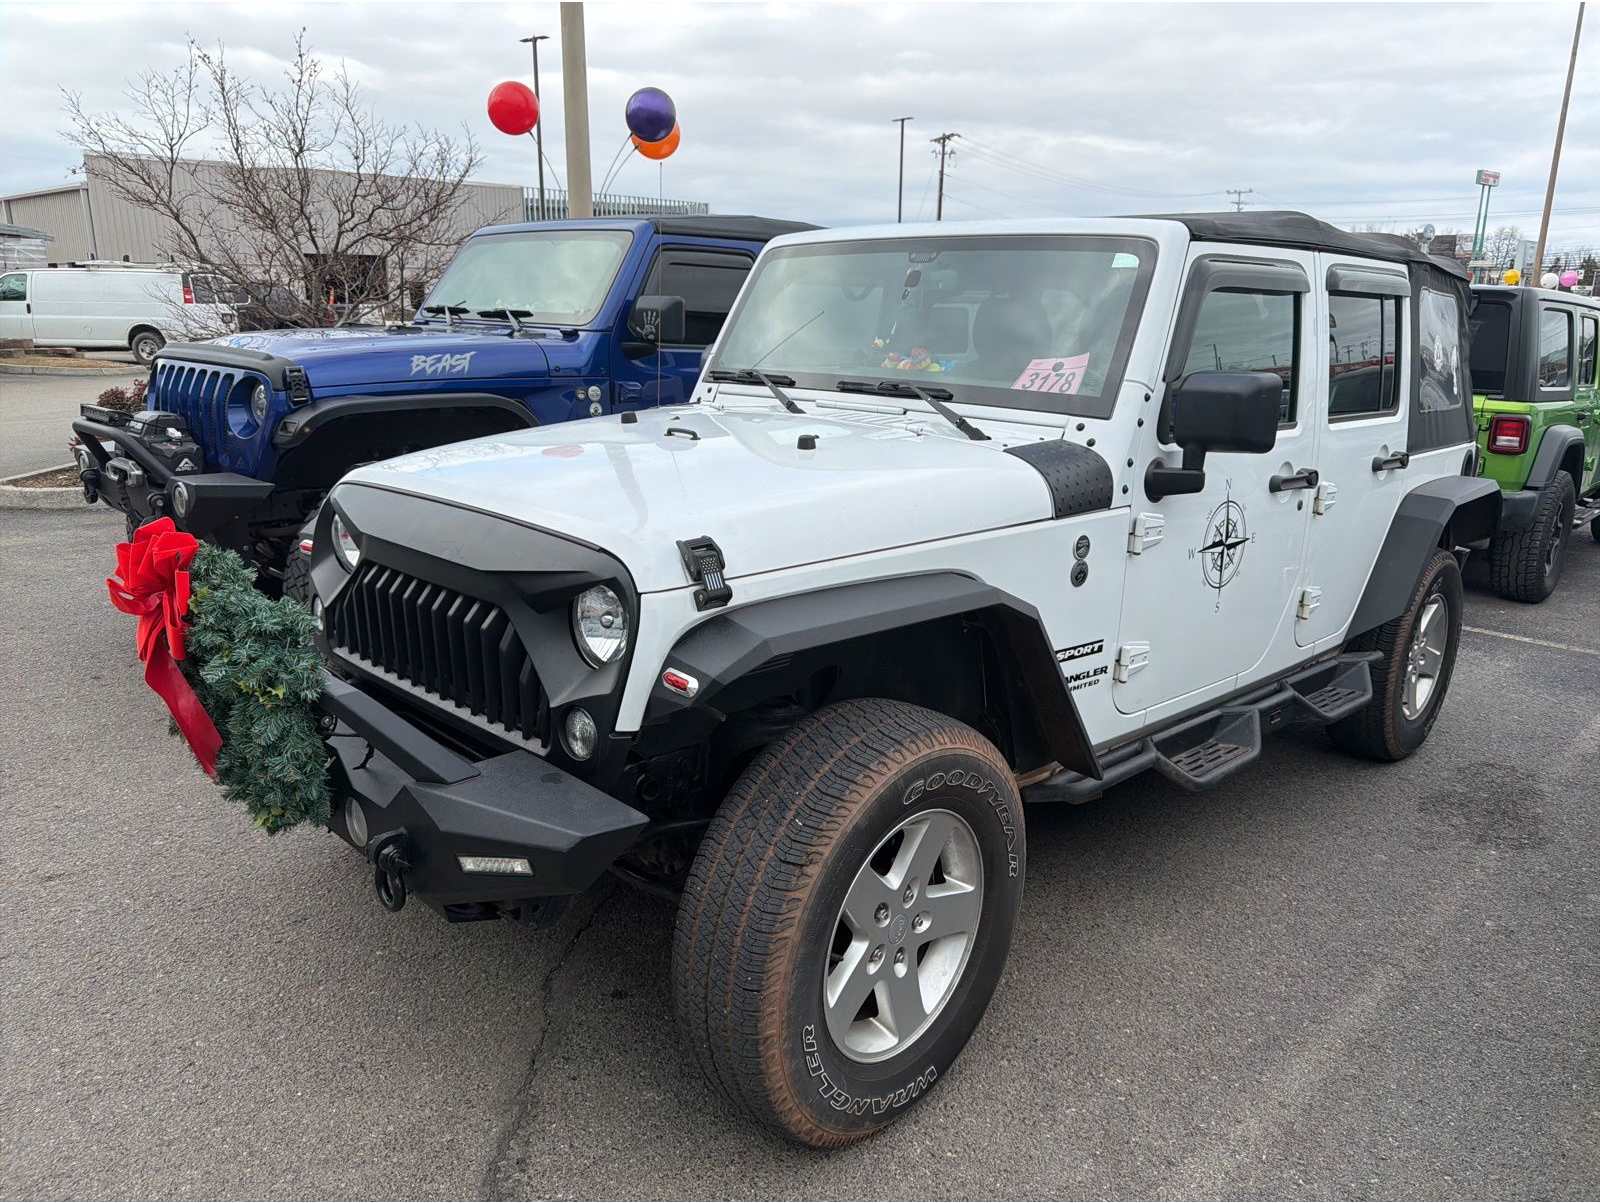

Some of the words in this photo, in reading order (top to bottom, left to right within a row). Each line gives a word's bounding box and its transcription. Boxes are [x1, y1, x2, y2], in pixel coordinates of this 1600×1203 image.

[410, 351, 477, 376] BEAST
[1021, 372, 1076, 392] 3178
[1225, 478, 1232, 490] N
[1251, 532, 1256, 544] E
[1188, 547, 1196, 560] W
[1215, 601, 1220, 614] S
[1056, 643, 1099, 661] SPORT
[903, 769, 1019, 878] GOODYEAR
[802, 1024, 938, 1116] WRANGLER
